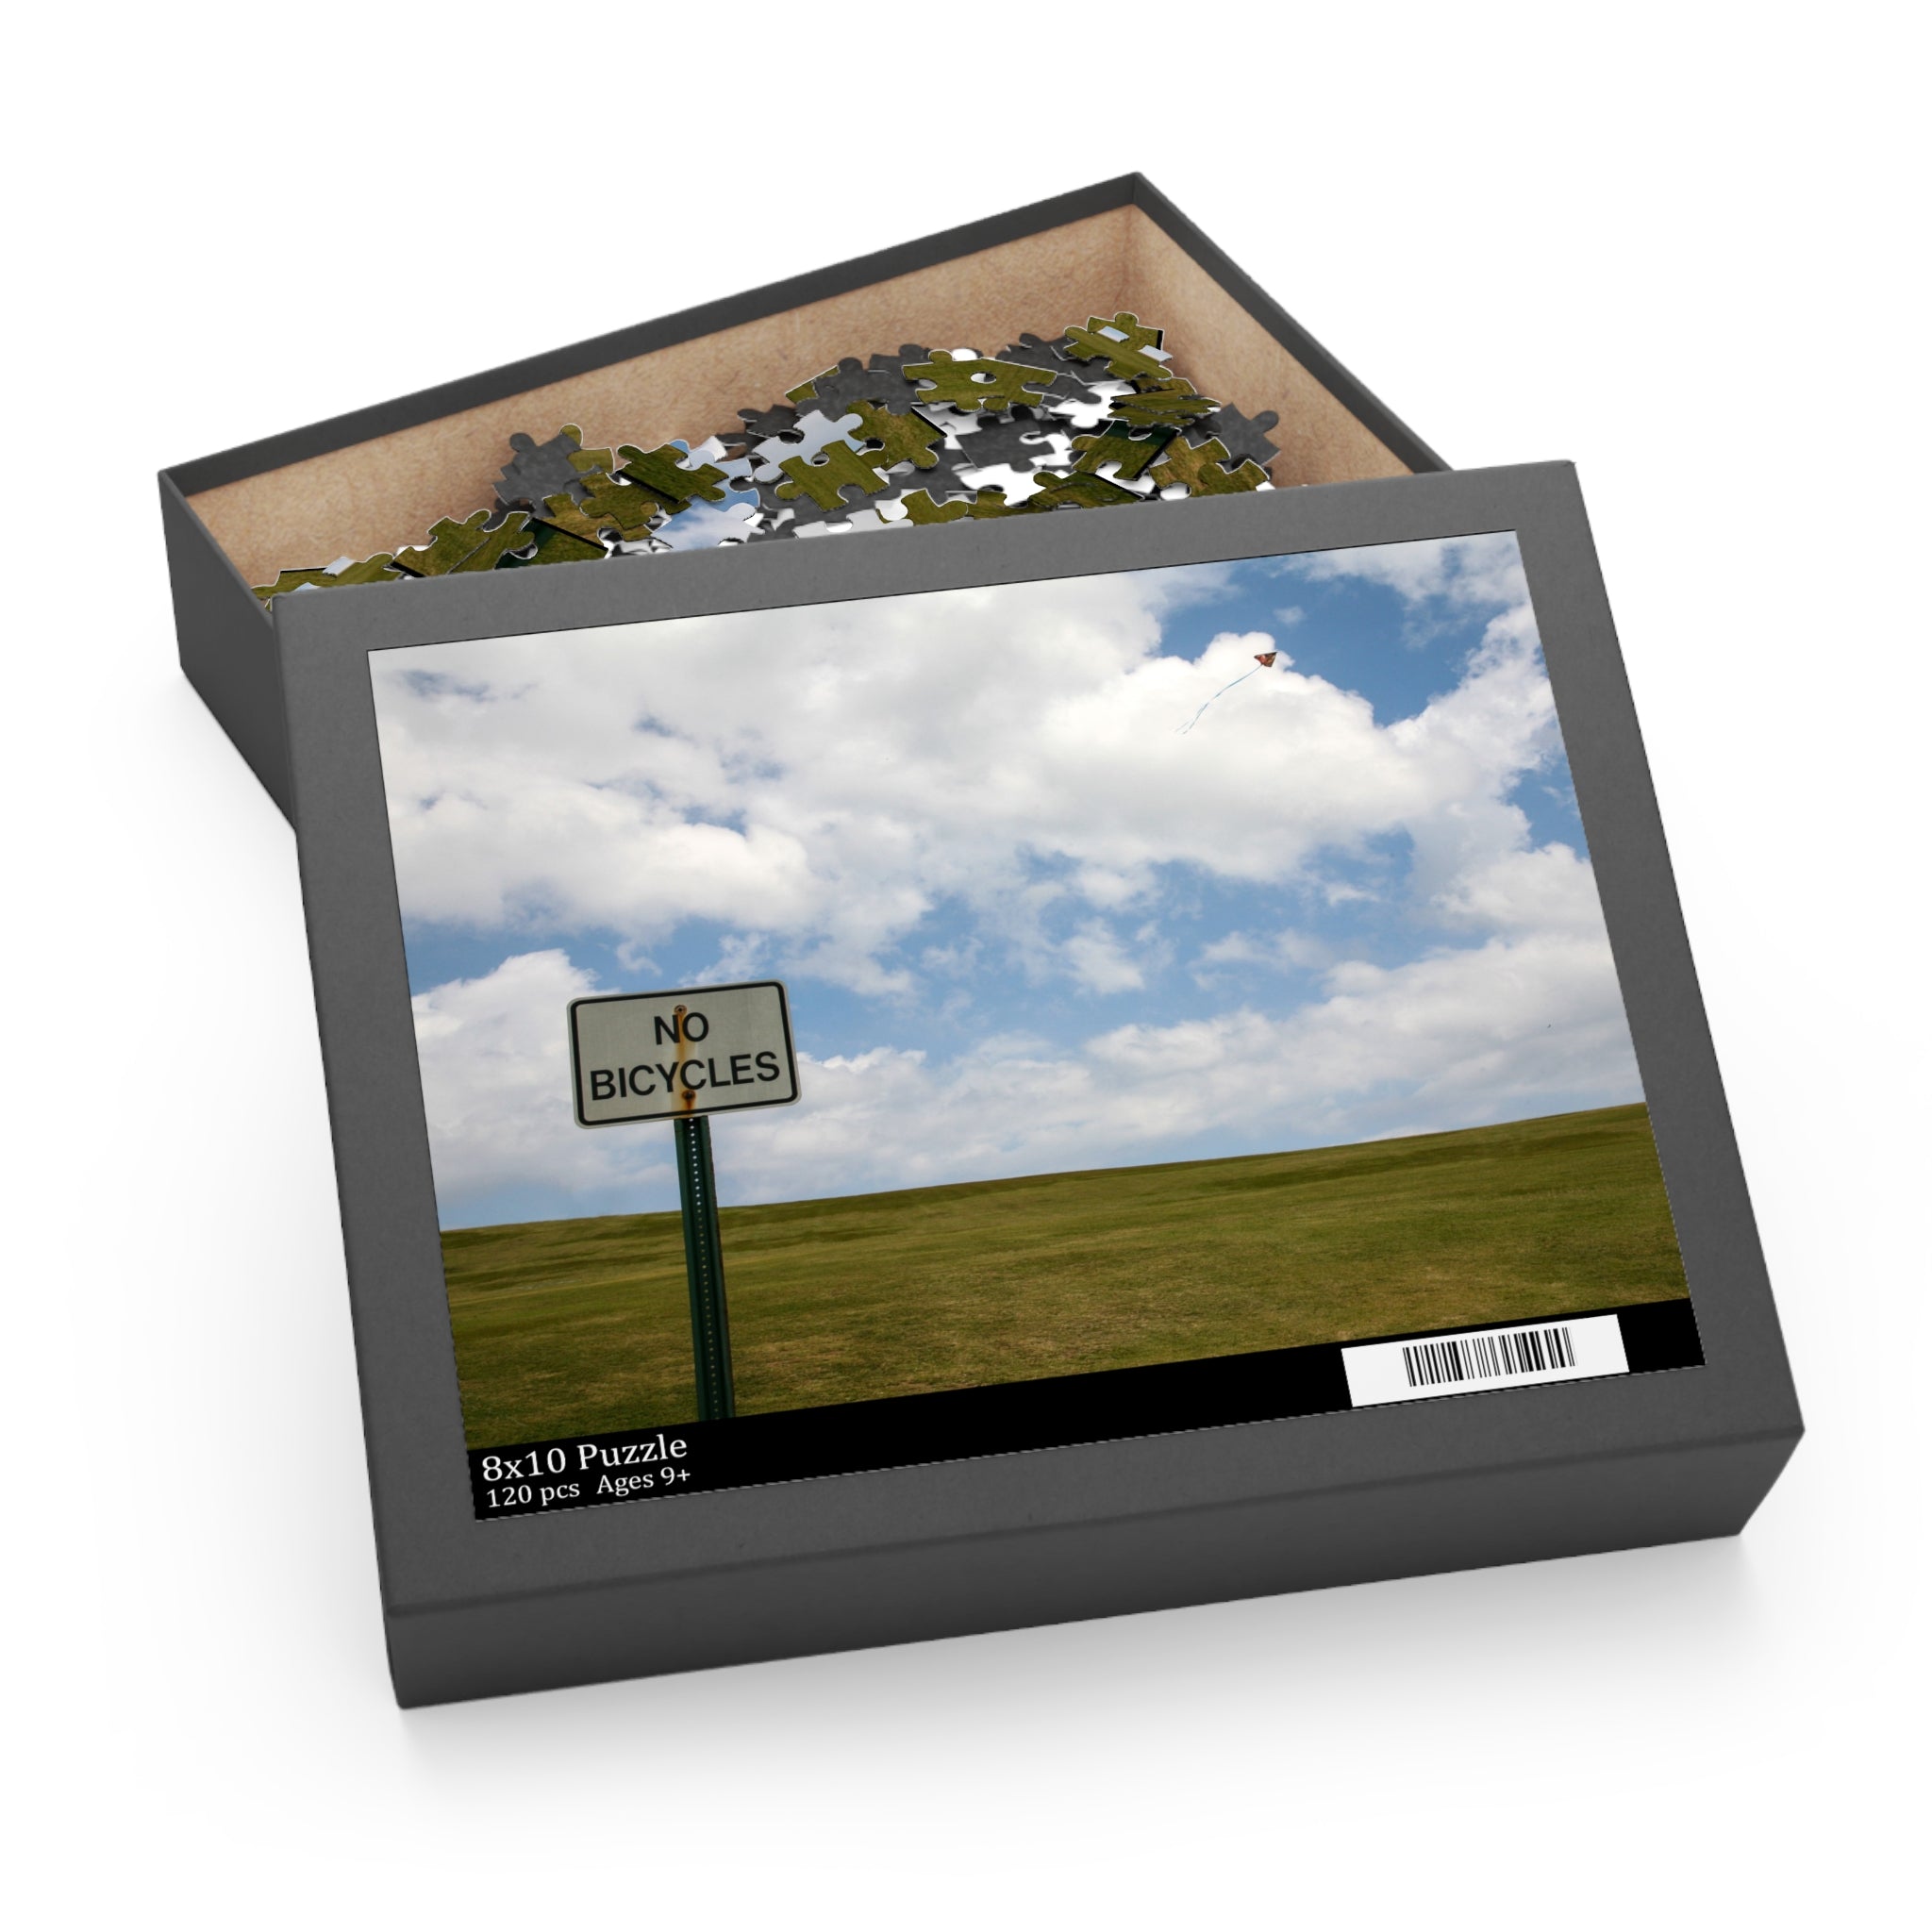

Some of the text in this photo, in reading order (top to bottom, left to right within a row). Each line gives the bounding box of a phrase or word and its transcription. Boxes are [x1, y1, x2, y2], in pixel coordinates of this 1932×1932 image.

[654, 1011, 709, 1045] NO
[590, 1051, 780, 1101] BICYCLES
[482, 1433, 688, 1481] 8x10 Puzzle
[486, 1466, 691, 1507] 120 pcs Ages 9+
